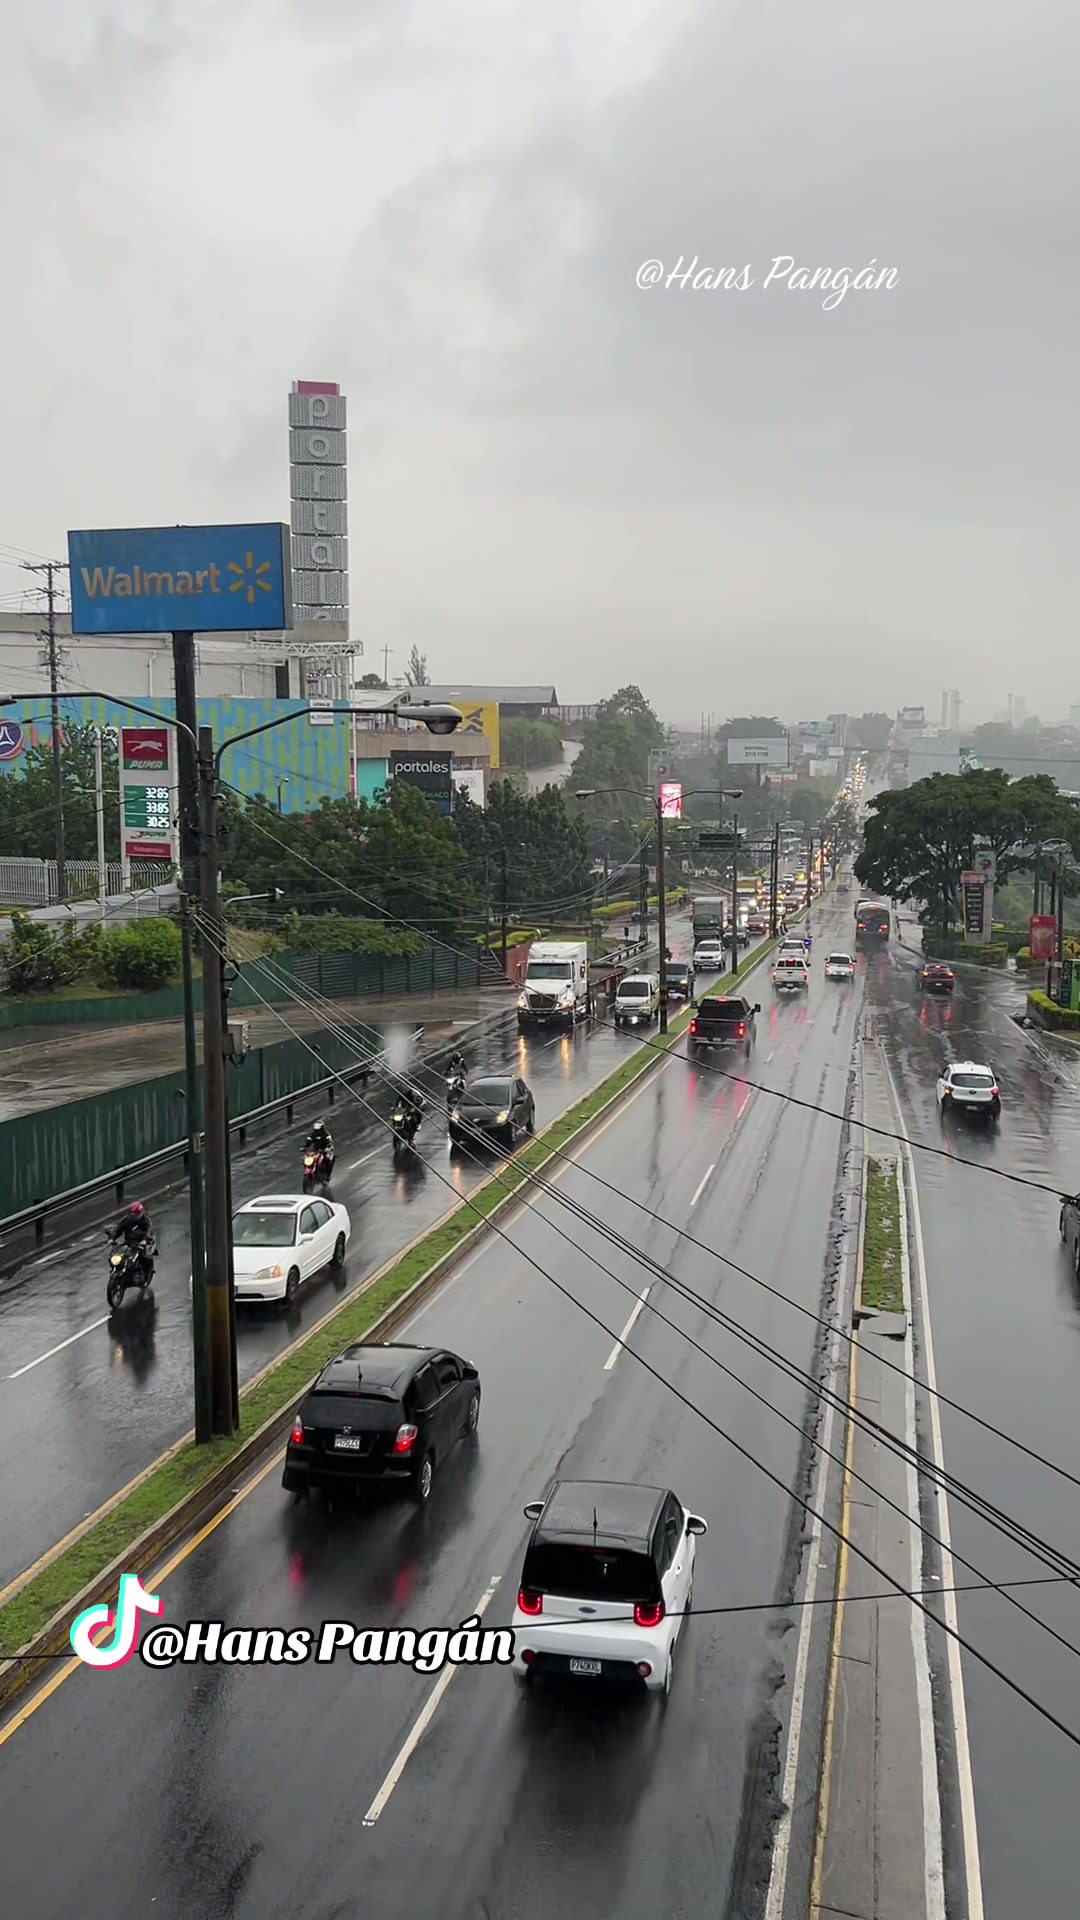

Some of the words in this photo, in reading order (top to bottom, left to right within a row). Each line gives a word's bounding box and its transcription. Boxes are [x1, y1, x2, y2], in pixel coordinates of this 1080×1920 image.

[81, 562, 221, 598] Walmart
[129, 760, 164, 769] PUMA
[395, 760, 449, 775] portales
